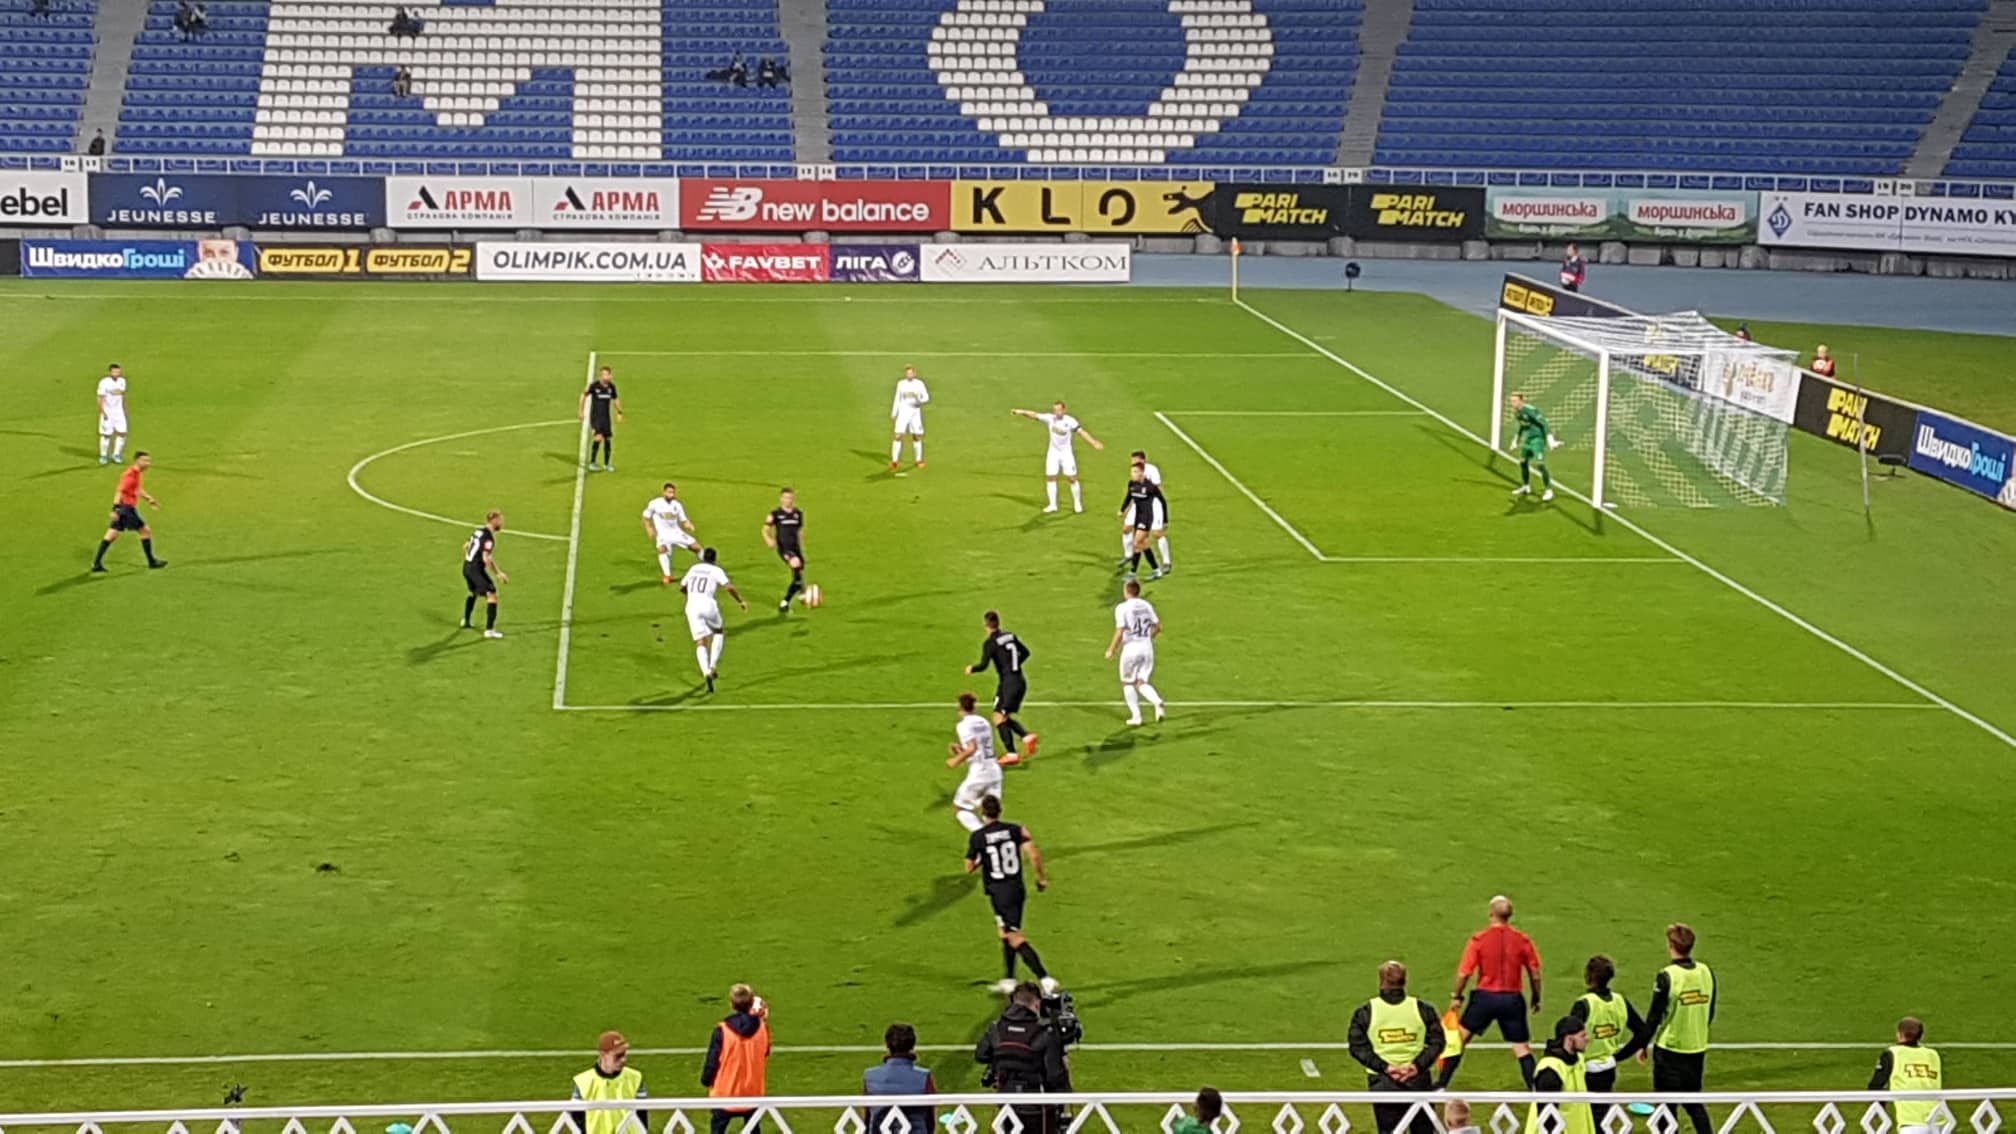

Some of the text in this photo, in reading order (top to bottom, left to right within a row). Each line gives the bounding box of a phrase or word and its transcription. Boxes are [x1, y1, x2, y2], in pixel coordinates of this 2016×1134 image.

[0, 188, 68, 217] ebel
[444, 190, 512, 211] АРМА
[591, 191, 660, 212] АРМА
[1249, 193, 1298, 207] PARI
[1384, 194, 1435, 210] PARI
[107, 209, 216, 224] JEUNESSE
[258, 212, 366, 225] JEUNESSE
[762, 199, 929, 222] new balance
[1257, 209, 1328, 224] MATCH
[1394, 211, 1465, 227] MATCH
[1502, 201, 1598, 219] моршинська
[1637, 202, 1736, 221] моршинська
[1804, 202, 1841, 218] FAN
[1845, 204, 1899, 220] SHOP
[1904, 206, 1988, 224] DYNAMO
[28, 247, 185, 269] ШвидкоГроші
[267, 250, 360, 272] ФУТБОЛ 1
[373, 250, 471, 273] ФУТБОЛ 2
[493, 250, 687, 270] OLIMPIK.COM.UA
[729, 255, 821, 269] FAVBET
[835, 256, 887, 269] ЛІГА
[978, 255, 1126, 271] АЛЬТКОМ
[986, 840, 1019, 880] 18
